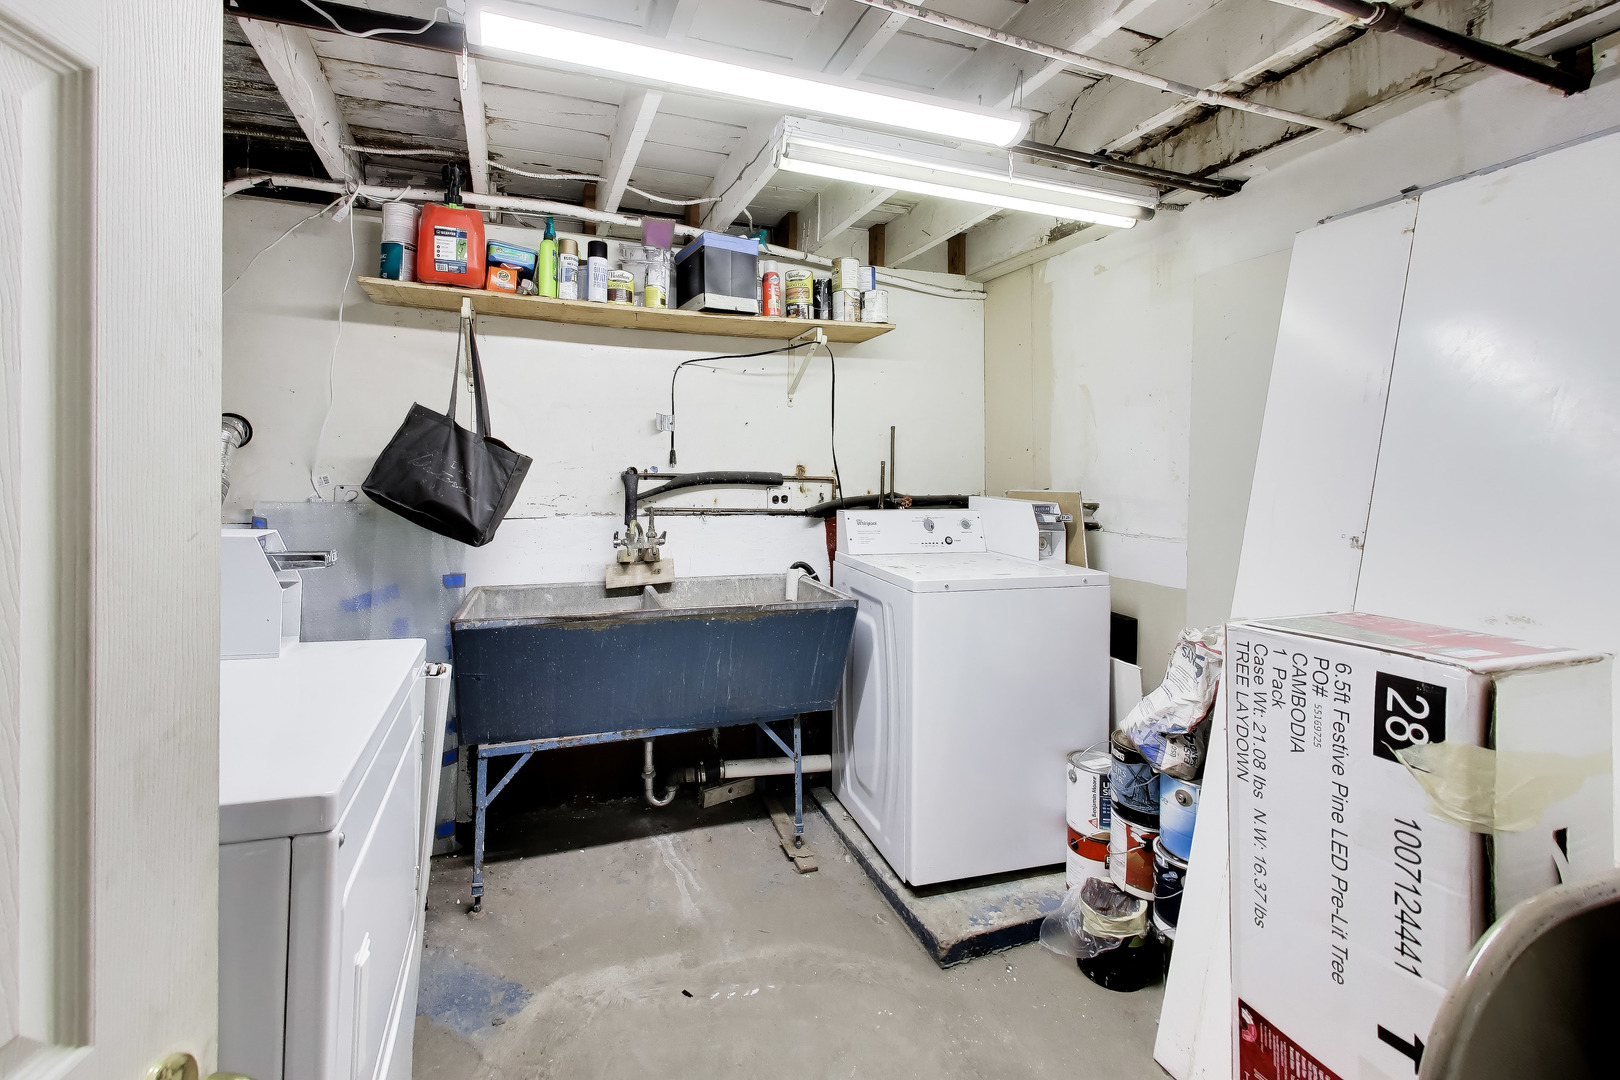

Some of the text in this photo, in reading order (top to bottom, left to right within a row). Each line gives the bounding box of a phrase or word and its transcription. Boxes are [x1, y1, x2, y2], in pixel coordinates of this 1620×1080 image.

[856, 519, 877, 527] Whirlpool
[1235, 640, 1250, 783] TREE LAYDOWN
[1271, 648, 1288, 710] 1 Pack
[1289, 652, 1309, 753] CAMBODIA
[1311, 656, 1330, 749] PO# 55169725
[1183, 742, 1191, 765] EASY
[1252, 643, 1269, 929] Case Wt: 21.08 lbs N.W: 16.37 lbs
[1330, 662, 1353, 985] 6.5ft Festive Pine LED Pre-Lit Tree
[1393, 817, 1423, 979] 1007124441
